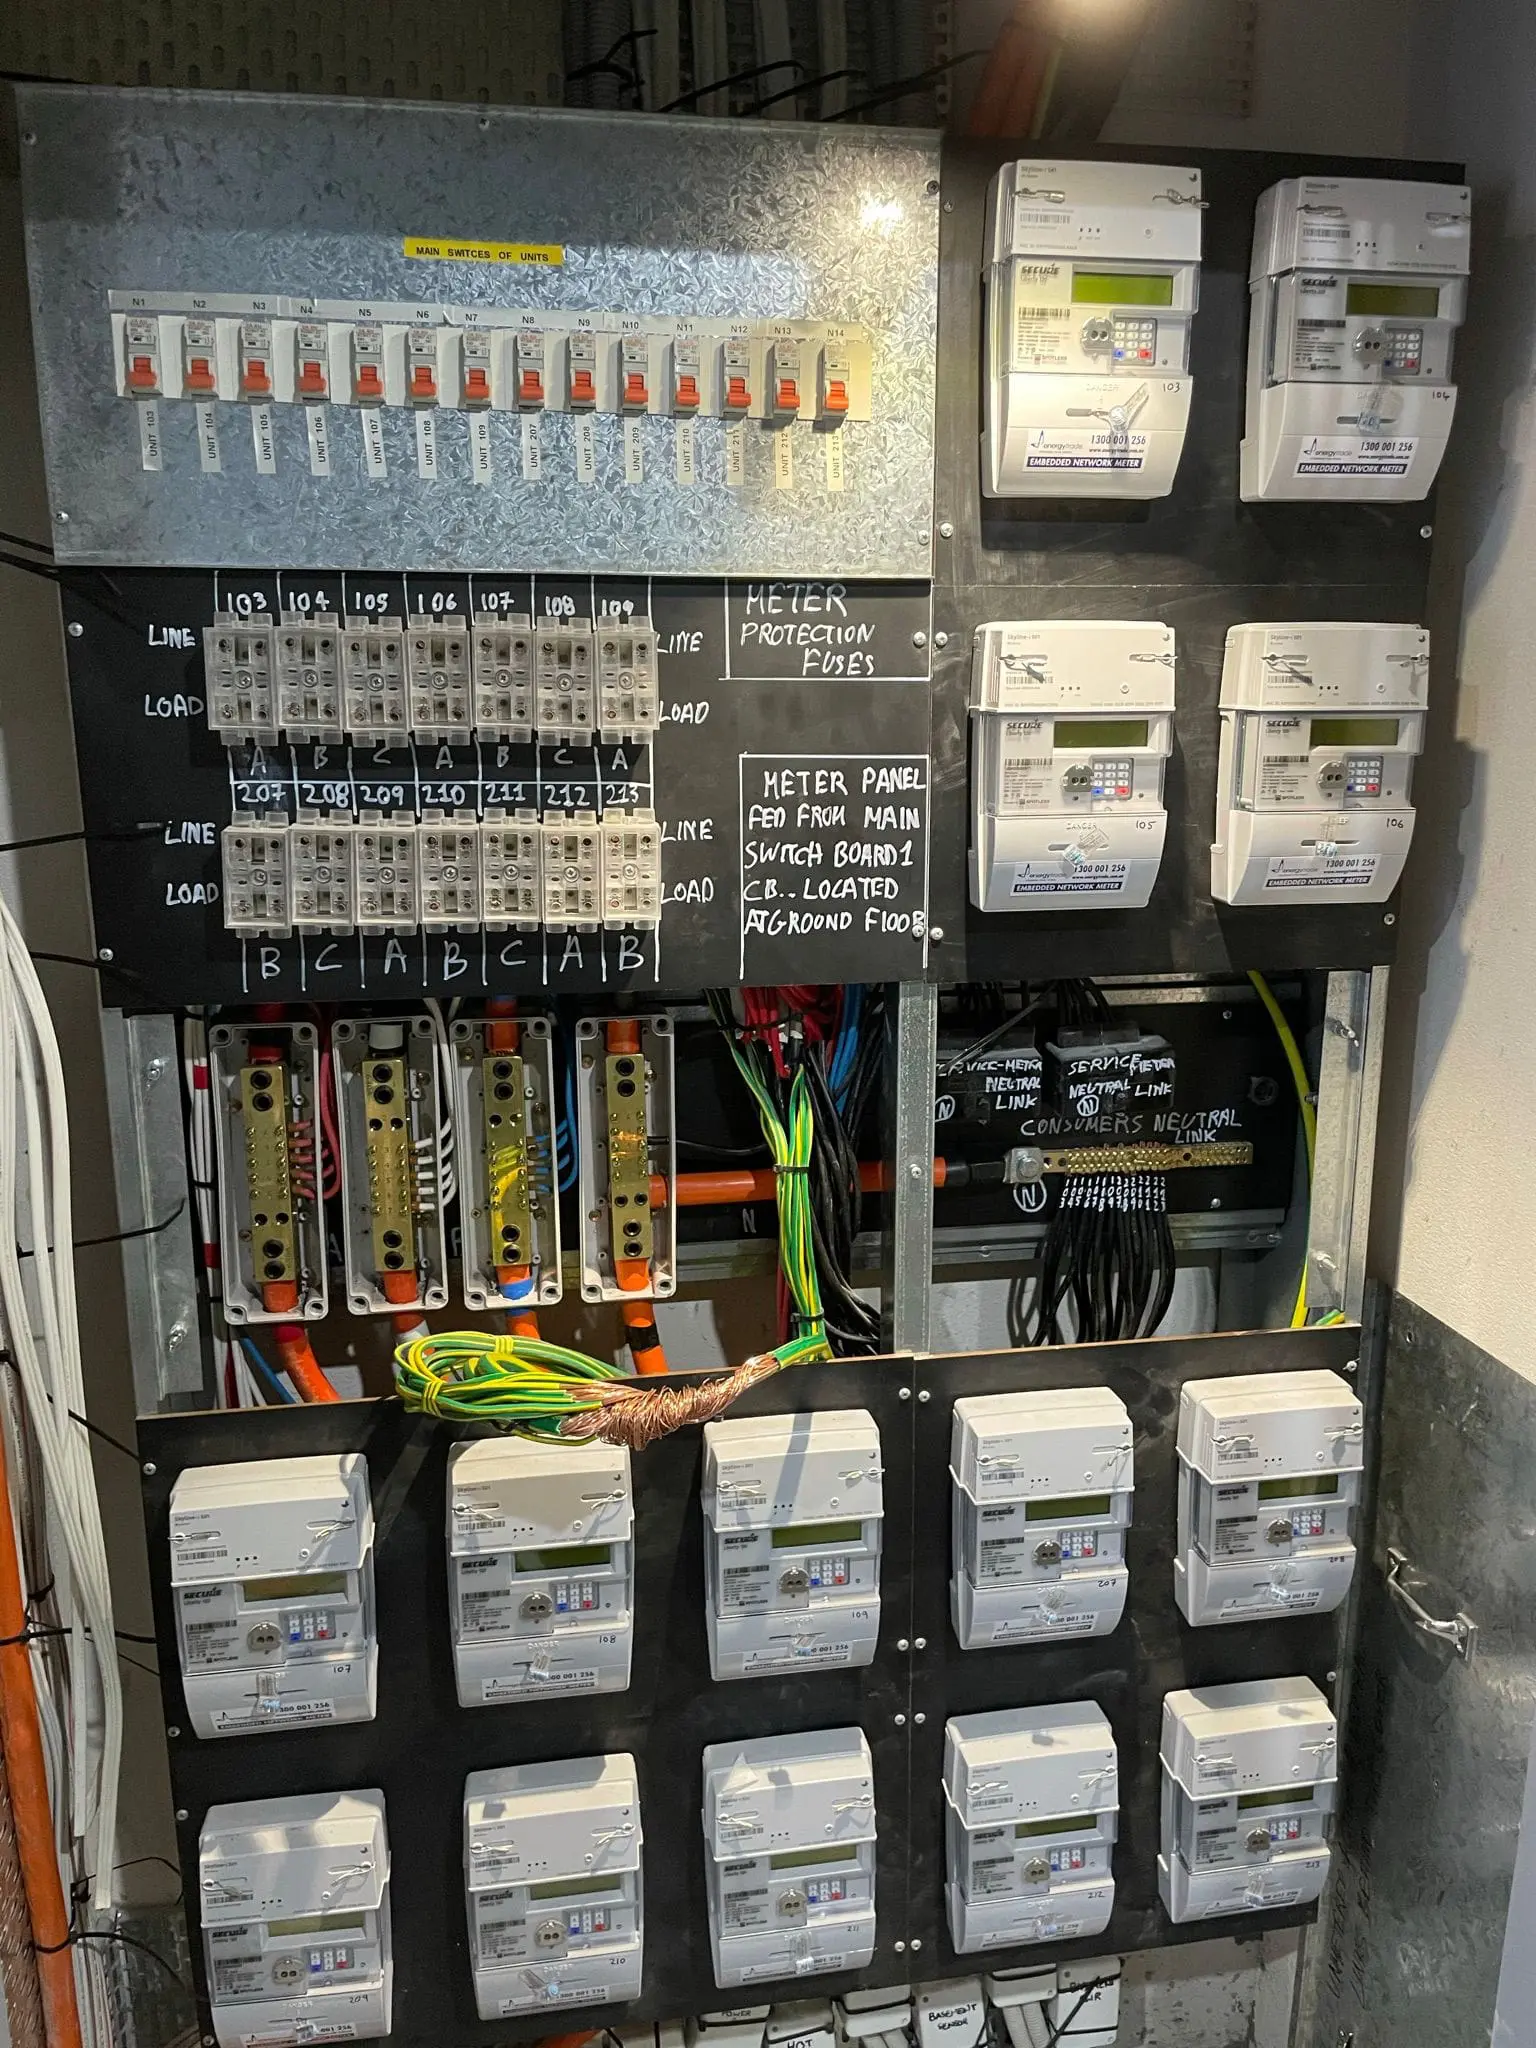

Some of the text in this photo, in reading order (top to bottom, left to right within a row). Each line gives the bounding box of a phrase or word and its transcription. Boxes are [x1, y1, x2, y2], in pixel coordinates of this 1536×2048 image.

[416, 247, 440, 255] MAIN
[448, 249, 490, 258] SWITCES
[521, 253, 549, 261] UNITS
[132, 298, 145, 307] N1
[193, 300, 206, 309] N2
[253, 301, 266, 310] N3
[300, 306, 313, 314] N4
[359, 308, 372, 317] N5
[416, 310, 429, 319] N6
[465, 313, 478, 321] N7
[522, 316, 535, 324] N8
[578, 318, 590, 327] N9
[622, 321, 639, 330] N10
[676, 323, 693, 332] N11
[730, 325, 747, 333] N12
[774, 326, 791, 335] N13
[827, 328, 844, 337] N14
[1162, 383, 1181, 392] 103
[148, 434, 158, 456] UNIT
[205, 413, 216, 459] UNIT 104
[260, 414, 271, 460] UNIT 105
[315, 417, 326, 462] UNIT 106
[370, 419, 382, 464] UNIT 107
[1091, 435, 1146, 445] 1300 001 256
[1360, 442, 1413, 451] 1300 001 256
[425, 443, 434, 465] UNIT
[480, 447, 488, 469] UNIT
[530, 446, 538, 468] UNIT
[583, 426, 592, 470] UNIT 208
[683, 450, 691, 472] UNIT
[732, 451, 740, 472] UNIT
[1029, 458, 1140, 467] EMBEDDED NETWORK METER
[1300, 464, 1404, 474] EMBEDDED NETWORK METER
[227, 592, 267, 615] 103
[289, 591, 330, 612] 104
[356, 592, 388, 612] 105
[419, 592, 458, 613] 106
[482, 591, 514, 612] 107
[545, 595, 575, 616] 108
[602, 600, 634, 616] 109
[746, 582, 848, 617] METER
[149, 624, 196, 649] LINE
[657, 632, 704, 653] LINE
[741, 622, 875, 645] PROTECTION
[803, 648, 874, 676] FUSES
[144, 694, 204, 717] LOAD
[659, 701, 710, 724] LOAD
[251, 746, 267, 776] A
[314, 746, 328, 770] B
[372, 746, 391, 765] C
[436, 746, 453, 770] A
[497, 747, 509, 767] B
[554, 749, 573, 765] C
[612, 748, 628, 770] A
[237, 783, 287, 801] 207
[485, 783, 526, 802] 211
[764, 767, 926, 799] METER PANEL
[302, 784, 349, 808] 208
[360, 785, 404, 806] 209
[422, 784, 466, 804] 210
[544, 784, 590, 806] 212
[606, 784, 639, 804] 213
[749, 803, 920, 830] FED FROM MAIN
[1136, 821, 1156, 830] 105
[1386, 818, 1404, 828] 106
[165, 820, 216, 845] LINE
[661, 819, 714, 842] LINE
[744, 841, 823, 869] SWITCH
[166, 883, 219, 905] LOAD
[660, 878, 714, 902] LOAD
[803, 877, 898, 900] LOCATED
[260, 947, 280, 979] B
[315, 943, 343, 971] C
[384, 938, 407, 974] A
[443, 940, 468, 980] B
[500, 940, 526, 966] C
[560, 935, 583, 972] A
[619, 935, 644, 971] B
[936, 1059, 1042, 1076] RVICE-METER
[1068, 1054, 1142, 1075] SERVICE
[985, 1077, 1041, 1092] NEUTRAL
[1069, 1079, 1172, 1099] NEUTRAL LINK
[996, 1094, 1037, 1110] LINK
[1021, 1108, 1242, 1137] CONSUMERS NEUTRAL
[1175, 1128, 1217, 1144] LINK
[852, 1611, 868, 1619] 109
